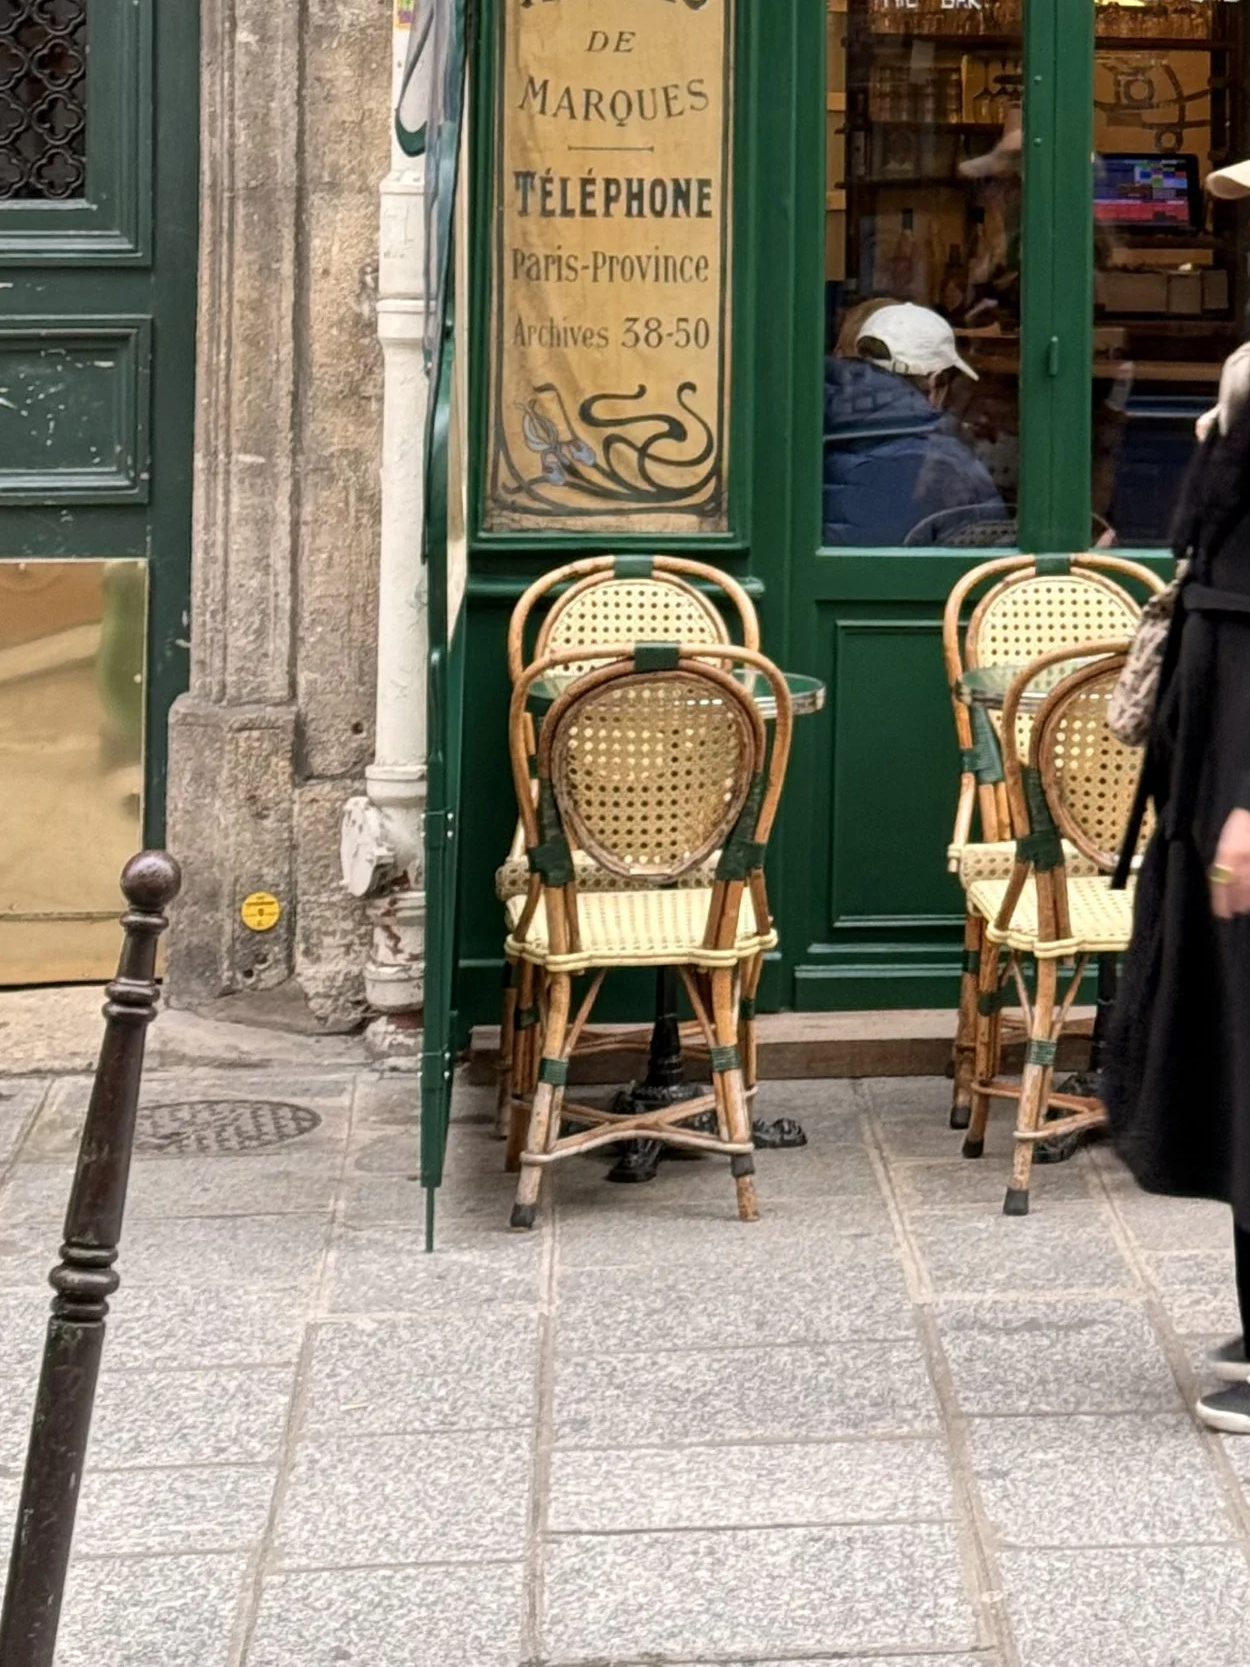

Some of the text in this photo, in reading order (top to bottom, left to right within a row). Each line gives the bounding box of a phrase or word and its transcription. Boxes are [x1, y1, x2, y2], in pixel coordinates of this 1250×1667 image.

[585, 29, 636, 54] DE
[517, 74, 709, 127] MARQUES
[513, 167, 714, 219] TÉLÉPHONE
[511, 245, 709, 283] Paris-Province
[513, 315, 711, 350] Archives 38-50
